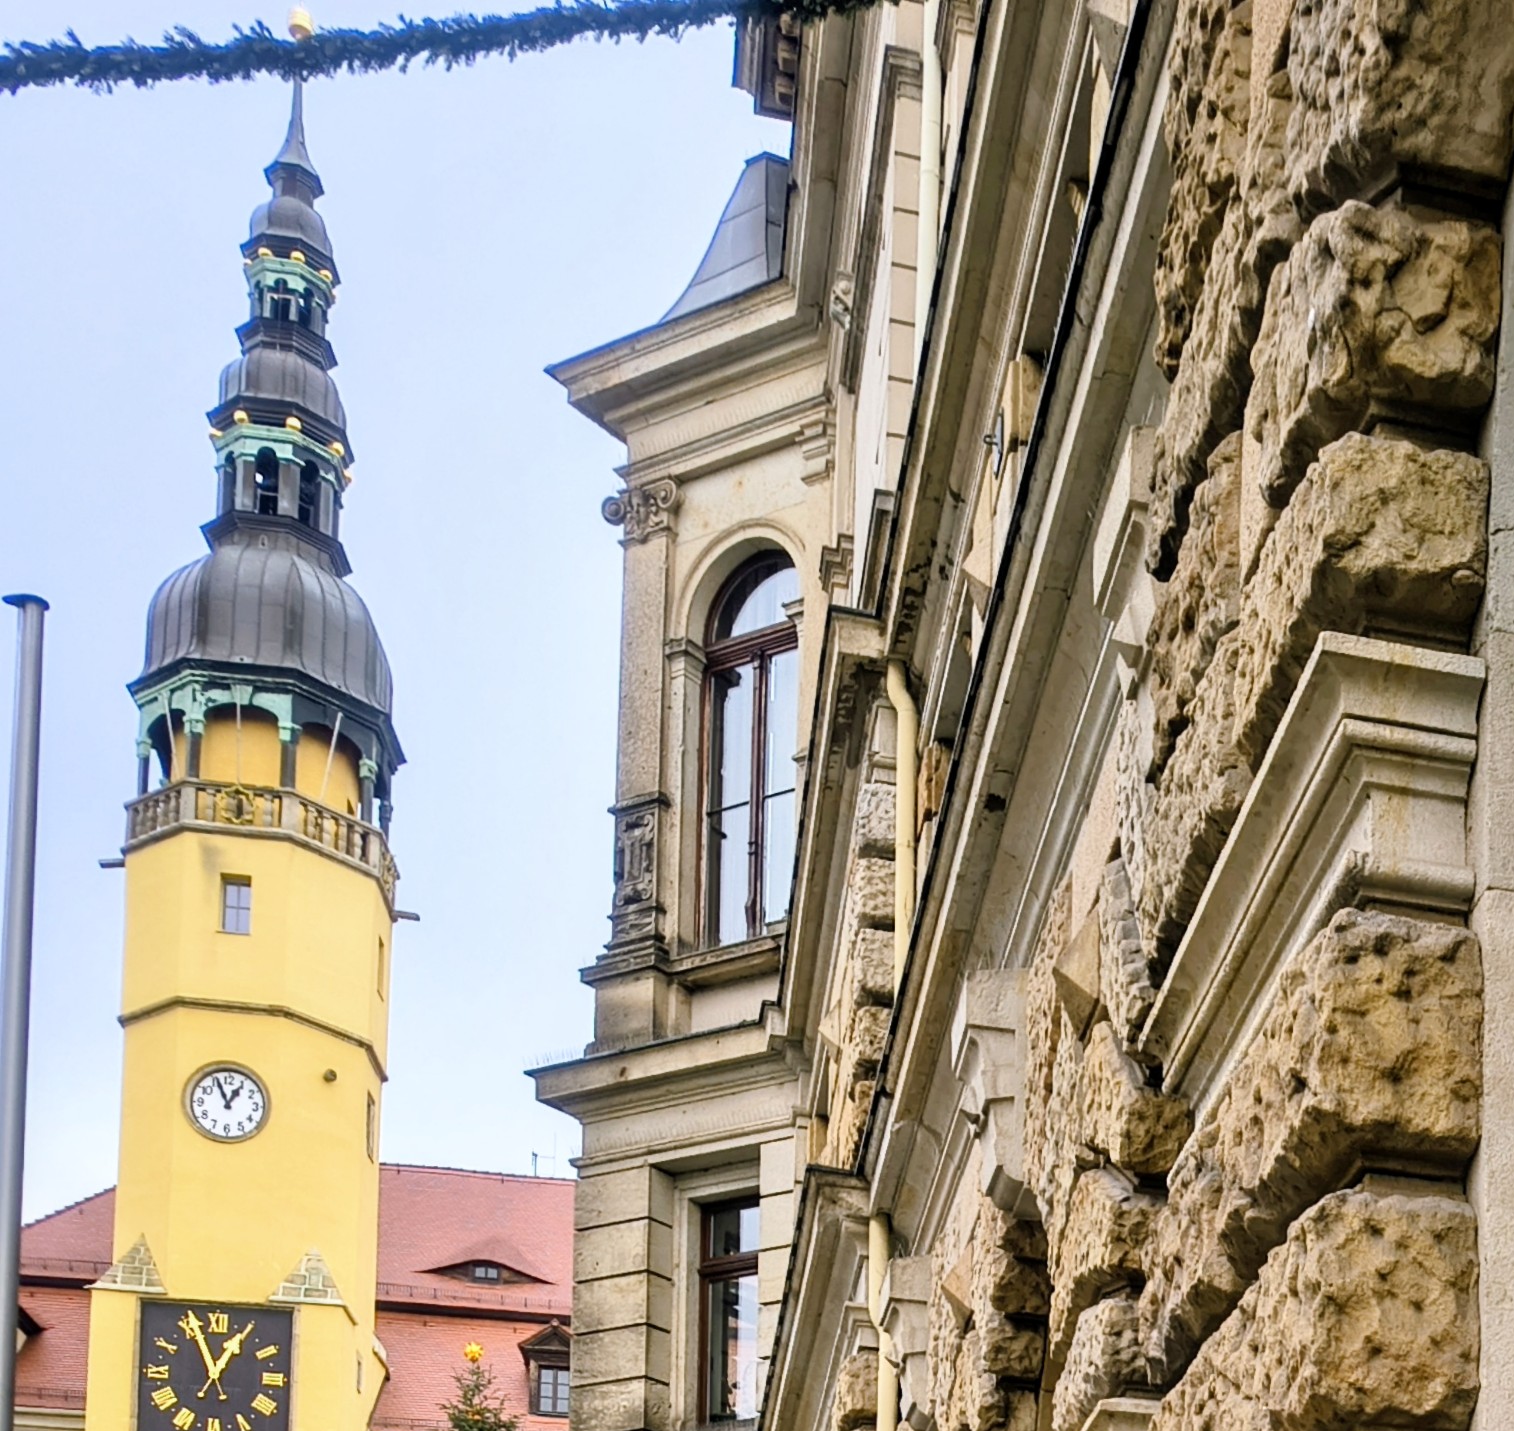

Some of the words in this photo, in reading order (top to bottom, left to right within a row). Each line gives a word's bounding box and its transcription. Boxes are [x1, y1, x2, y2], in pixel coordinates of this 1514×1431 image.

[202, 1085, 213, 1096] 10
[248, 1090, 255, 1100] 2
[197, 1097, 205, 1107] 9
[252, 1102, 259, 1112] 3
[201, 1110, 209, 1120] 8
[211, 1119, 218, 1129] 7
[207, 1312, 229, 1333] XII
[155, 1337, 178, 1355] X
